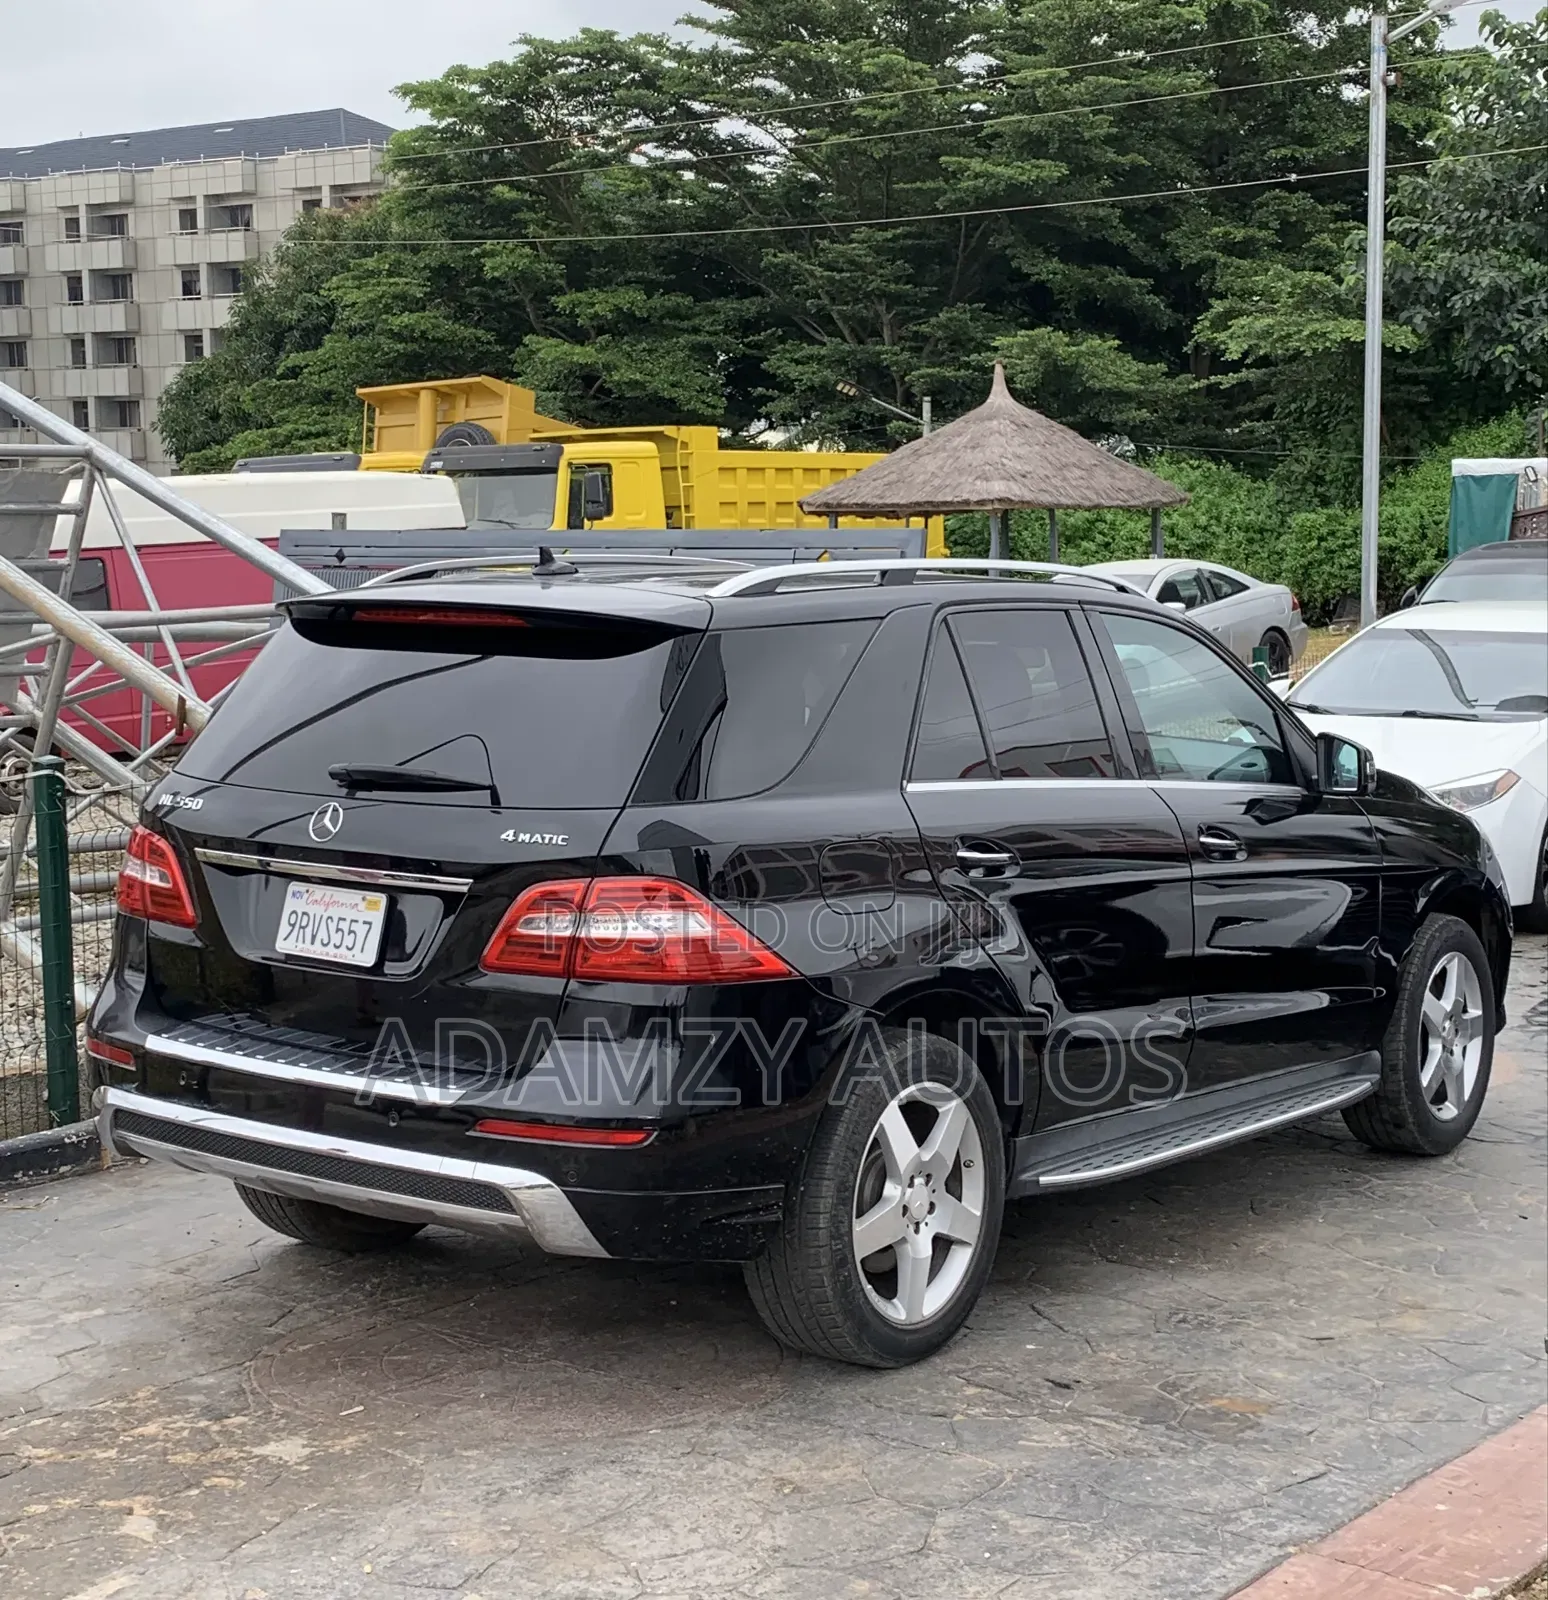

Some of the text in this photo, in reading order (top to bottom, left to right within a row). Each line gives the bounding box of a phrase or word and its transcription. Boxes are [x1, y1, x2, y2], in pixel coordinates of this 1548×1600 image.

[291, 890, 305, 900] NOV
[305, 889, 364, 912] California
[283, 909, 373, 954] 9RVS557
